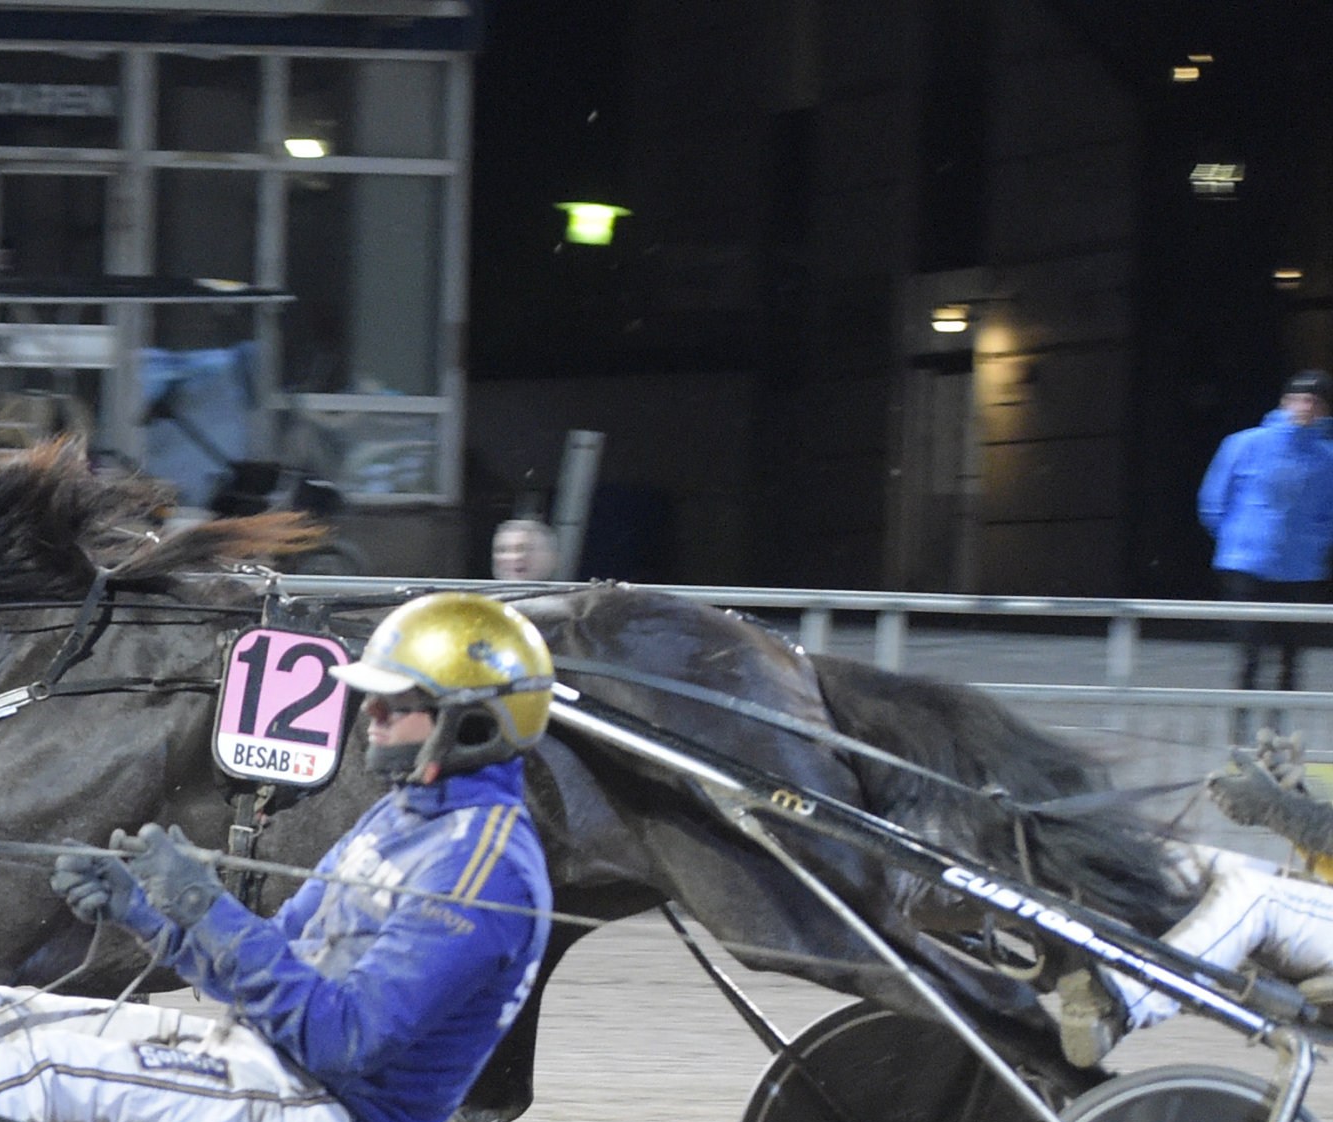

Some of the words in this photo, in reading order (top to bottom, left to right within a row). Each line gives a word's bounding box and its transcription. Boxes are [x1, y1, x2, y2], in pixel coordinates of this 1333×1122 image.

[237, 635, 339, 746] 12
[233, 743, 291, 772] BESAB
[941, 866, 1094, 944] CUSTOM
